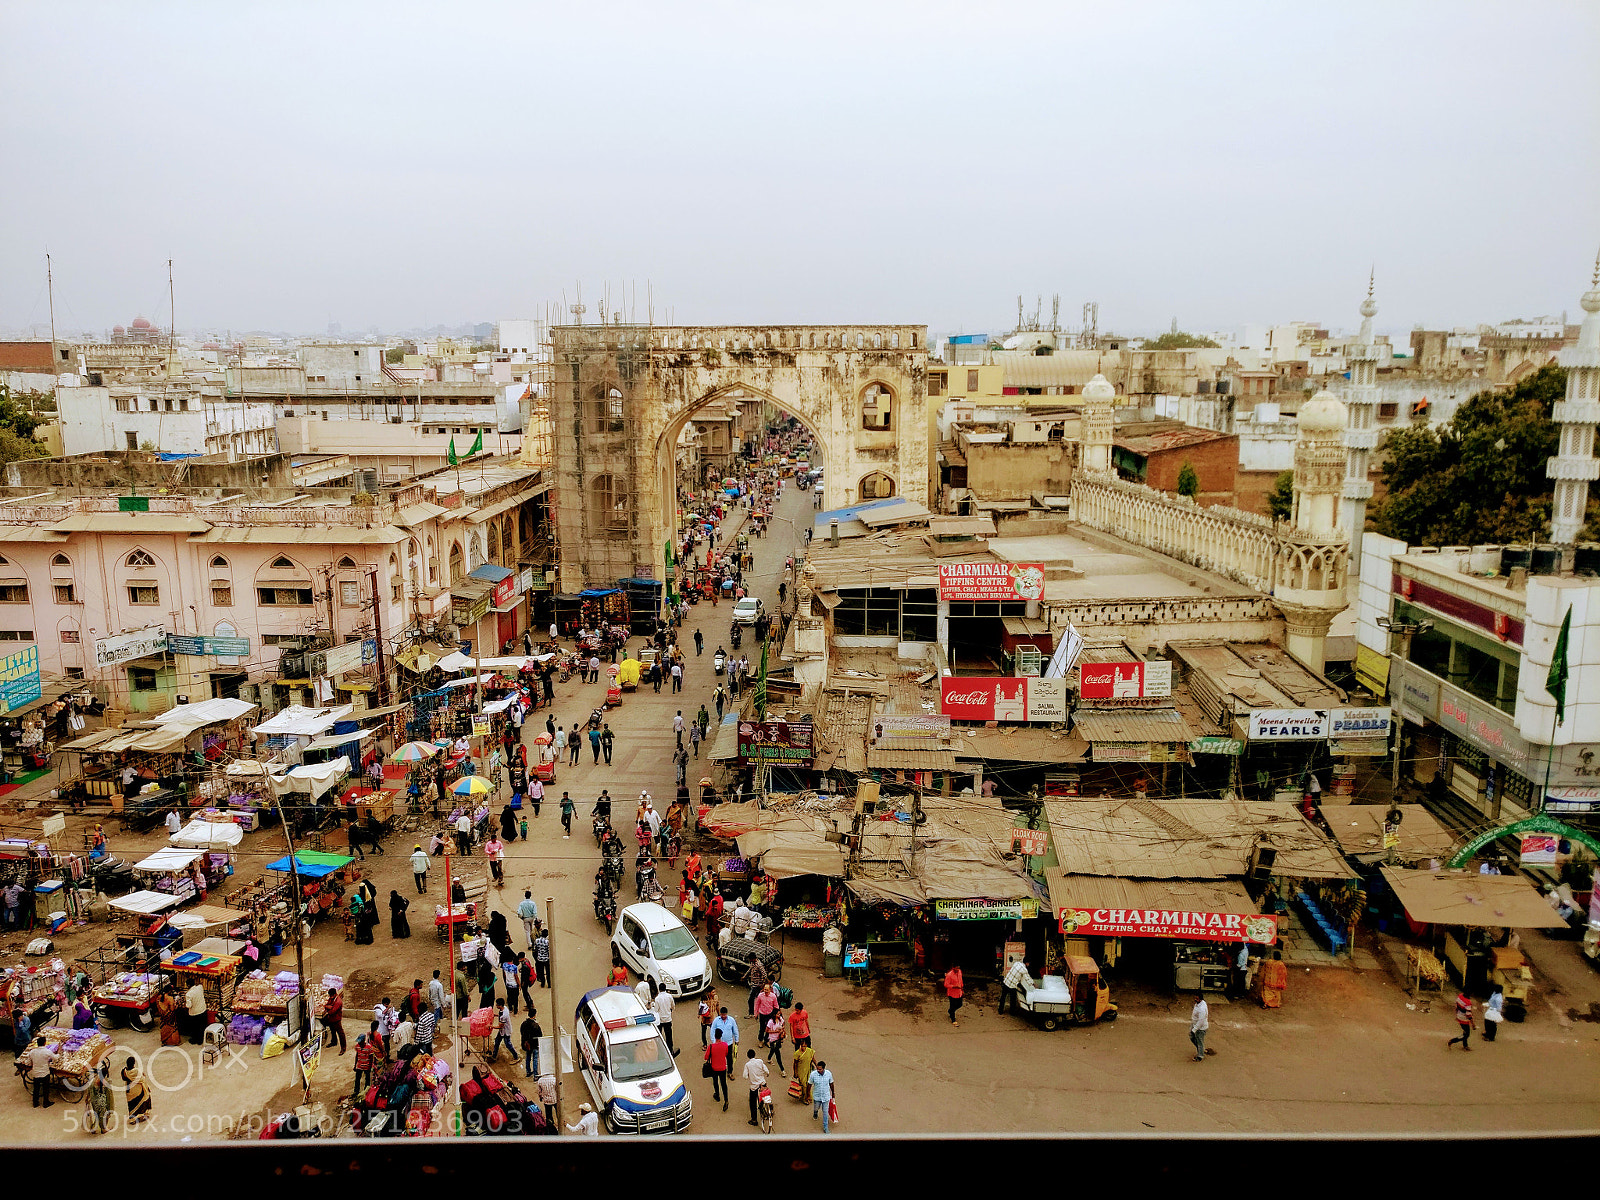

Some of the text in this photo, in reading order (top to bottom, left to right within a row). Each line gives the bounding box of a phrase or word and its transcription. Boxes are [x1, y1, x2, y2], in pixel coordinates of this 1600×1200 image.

[941, 564, 1008, 577] CHARMINAR
[944, 577, 1007, 586] TIFFINS CENTRE
[1084, 674, 1113, 684] Coca-Cola
[945, 690, 990, 705] Coca-Cola
[1343, 710, 1379, 720] Madam's
[1260, 726, 1321, 736] PEARLS
[1333, 719, 1389, 731] PEARLS
[1190, 737, 1241, 754] Sprite
[1013, 829, 1048, 841] CLOAK ROOM
[938, 899, 1021, 908] CHARMINAR BANGLES
[1093, 909, 1241, 929] CHARMINAR
[1092, 924, 1242, 938] TIFFINS, CHAT, JUICE & TEA
